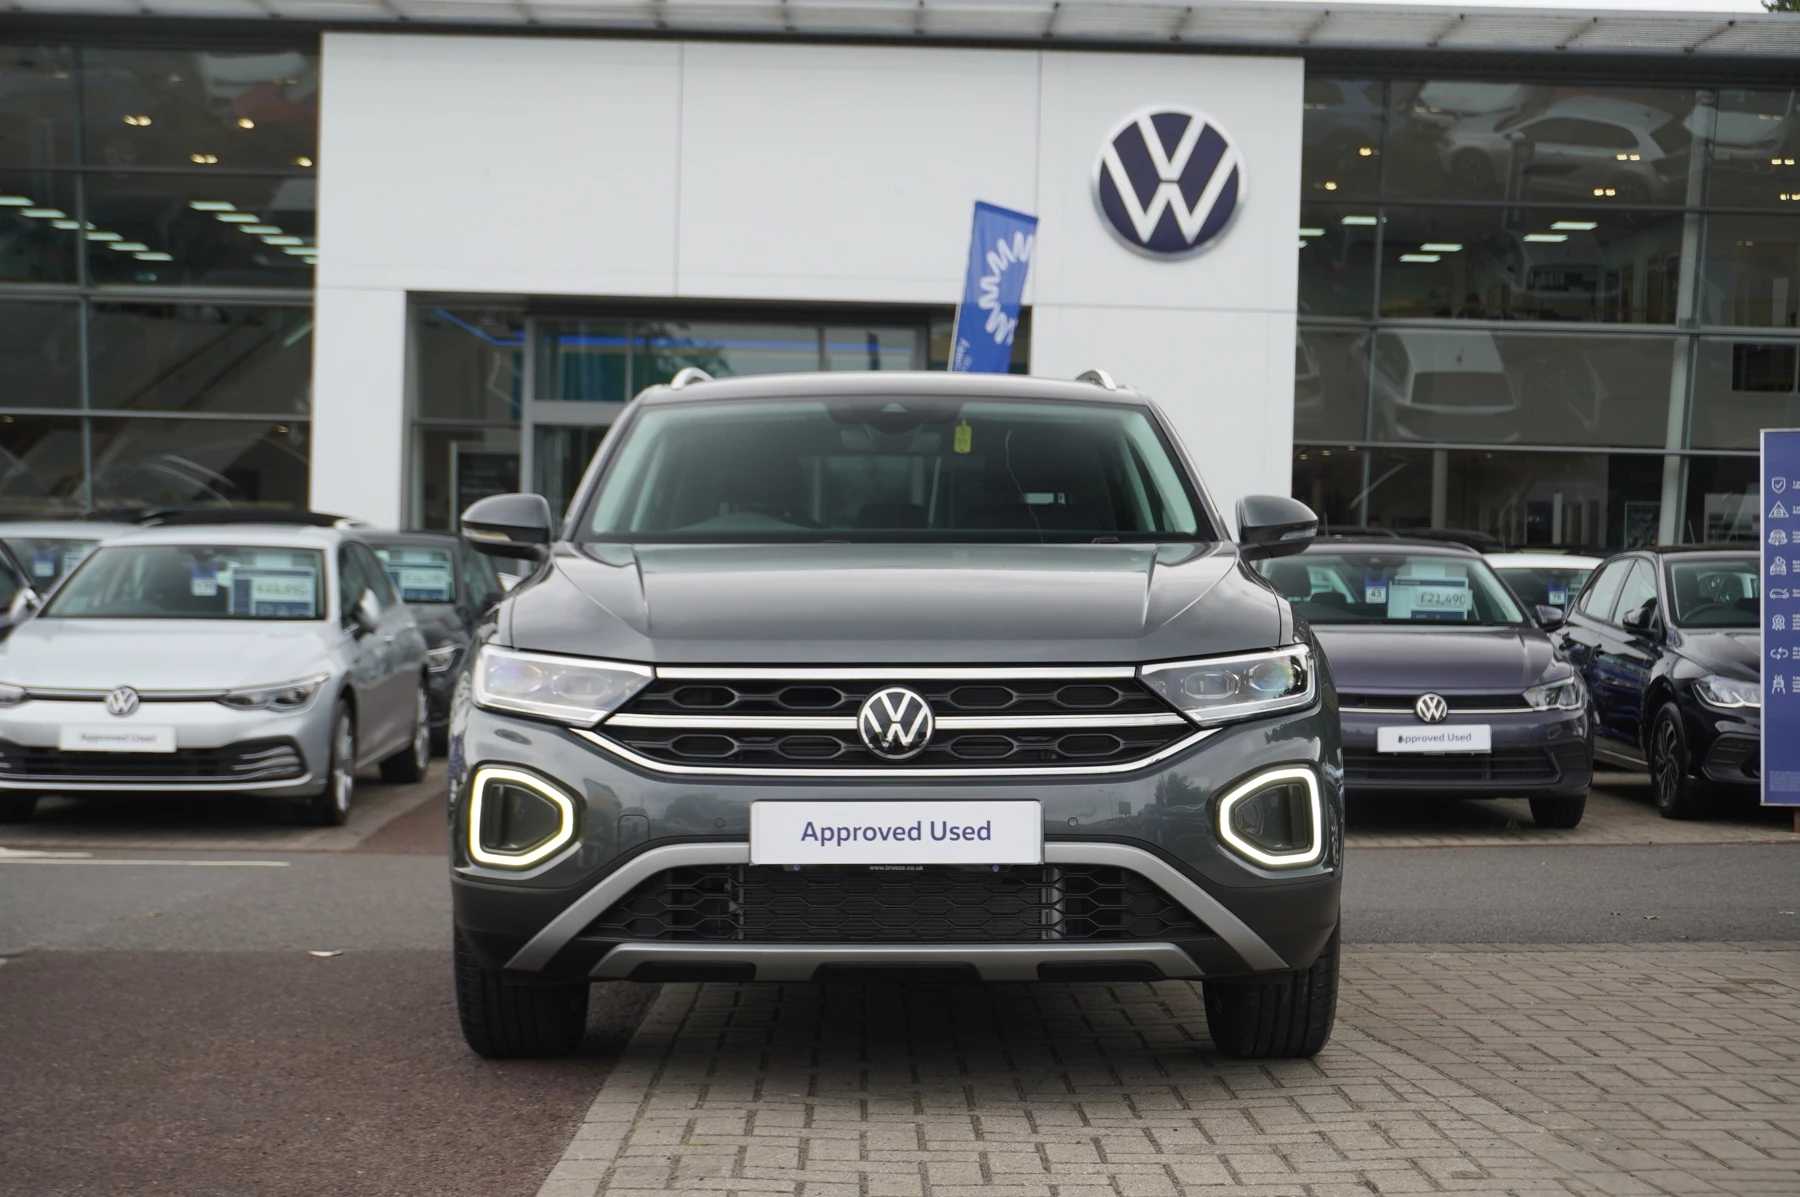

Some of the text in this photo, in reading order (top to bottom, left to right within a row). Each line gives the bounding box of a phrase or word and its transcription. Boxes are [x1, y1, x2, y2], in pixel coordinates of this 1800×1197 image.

[1098, 107, 1243, 252] VW
[1420, 591, 1466, 606] £21,490
[860, 687, 932, 756] VW
[1417, 694, 1447, 722] VW
[1398, 731, 1472, 744] Approved Used
[801, 820, 991, 847] Approved Used
[869, 864, 924, 872] www.breeze.co.uk
